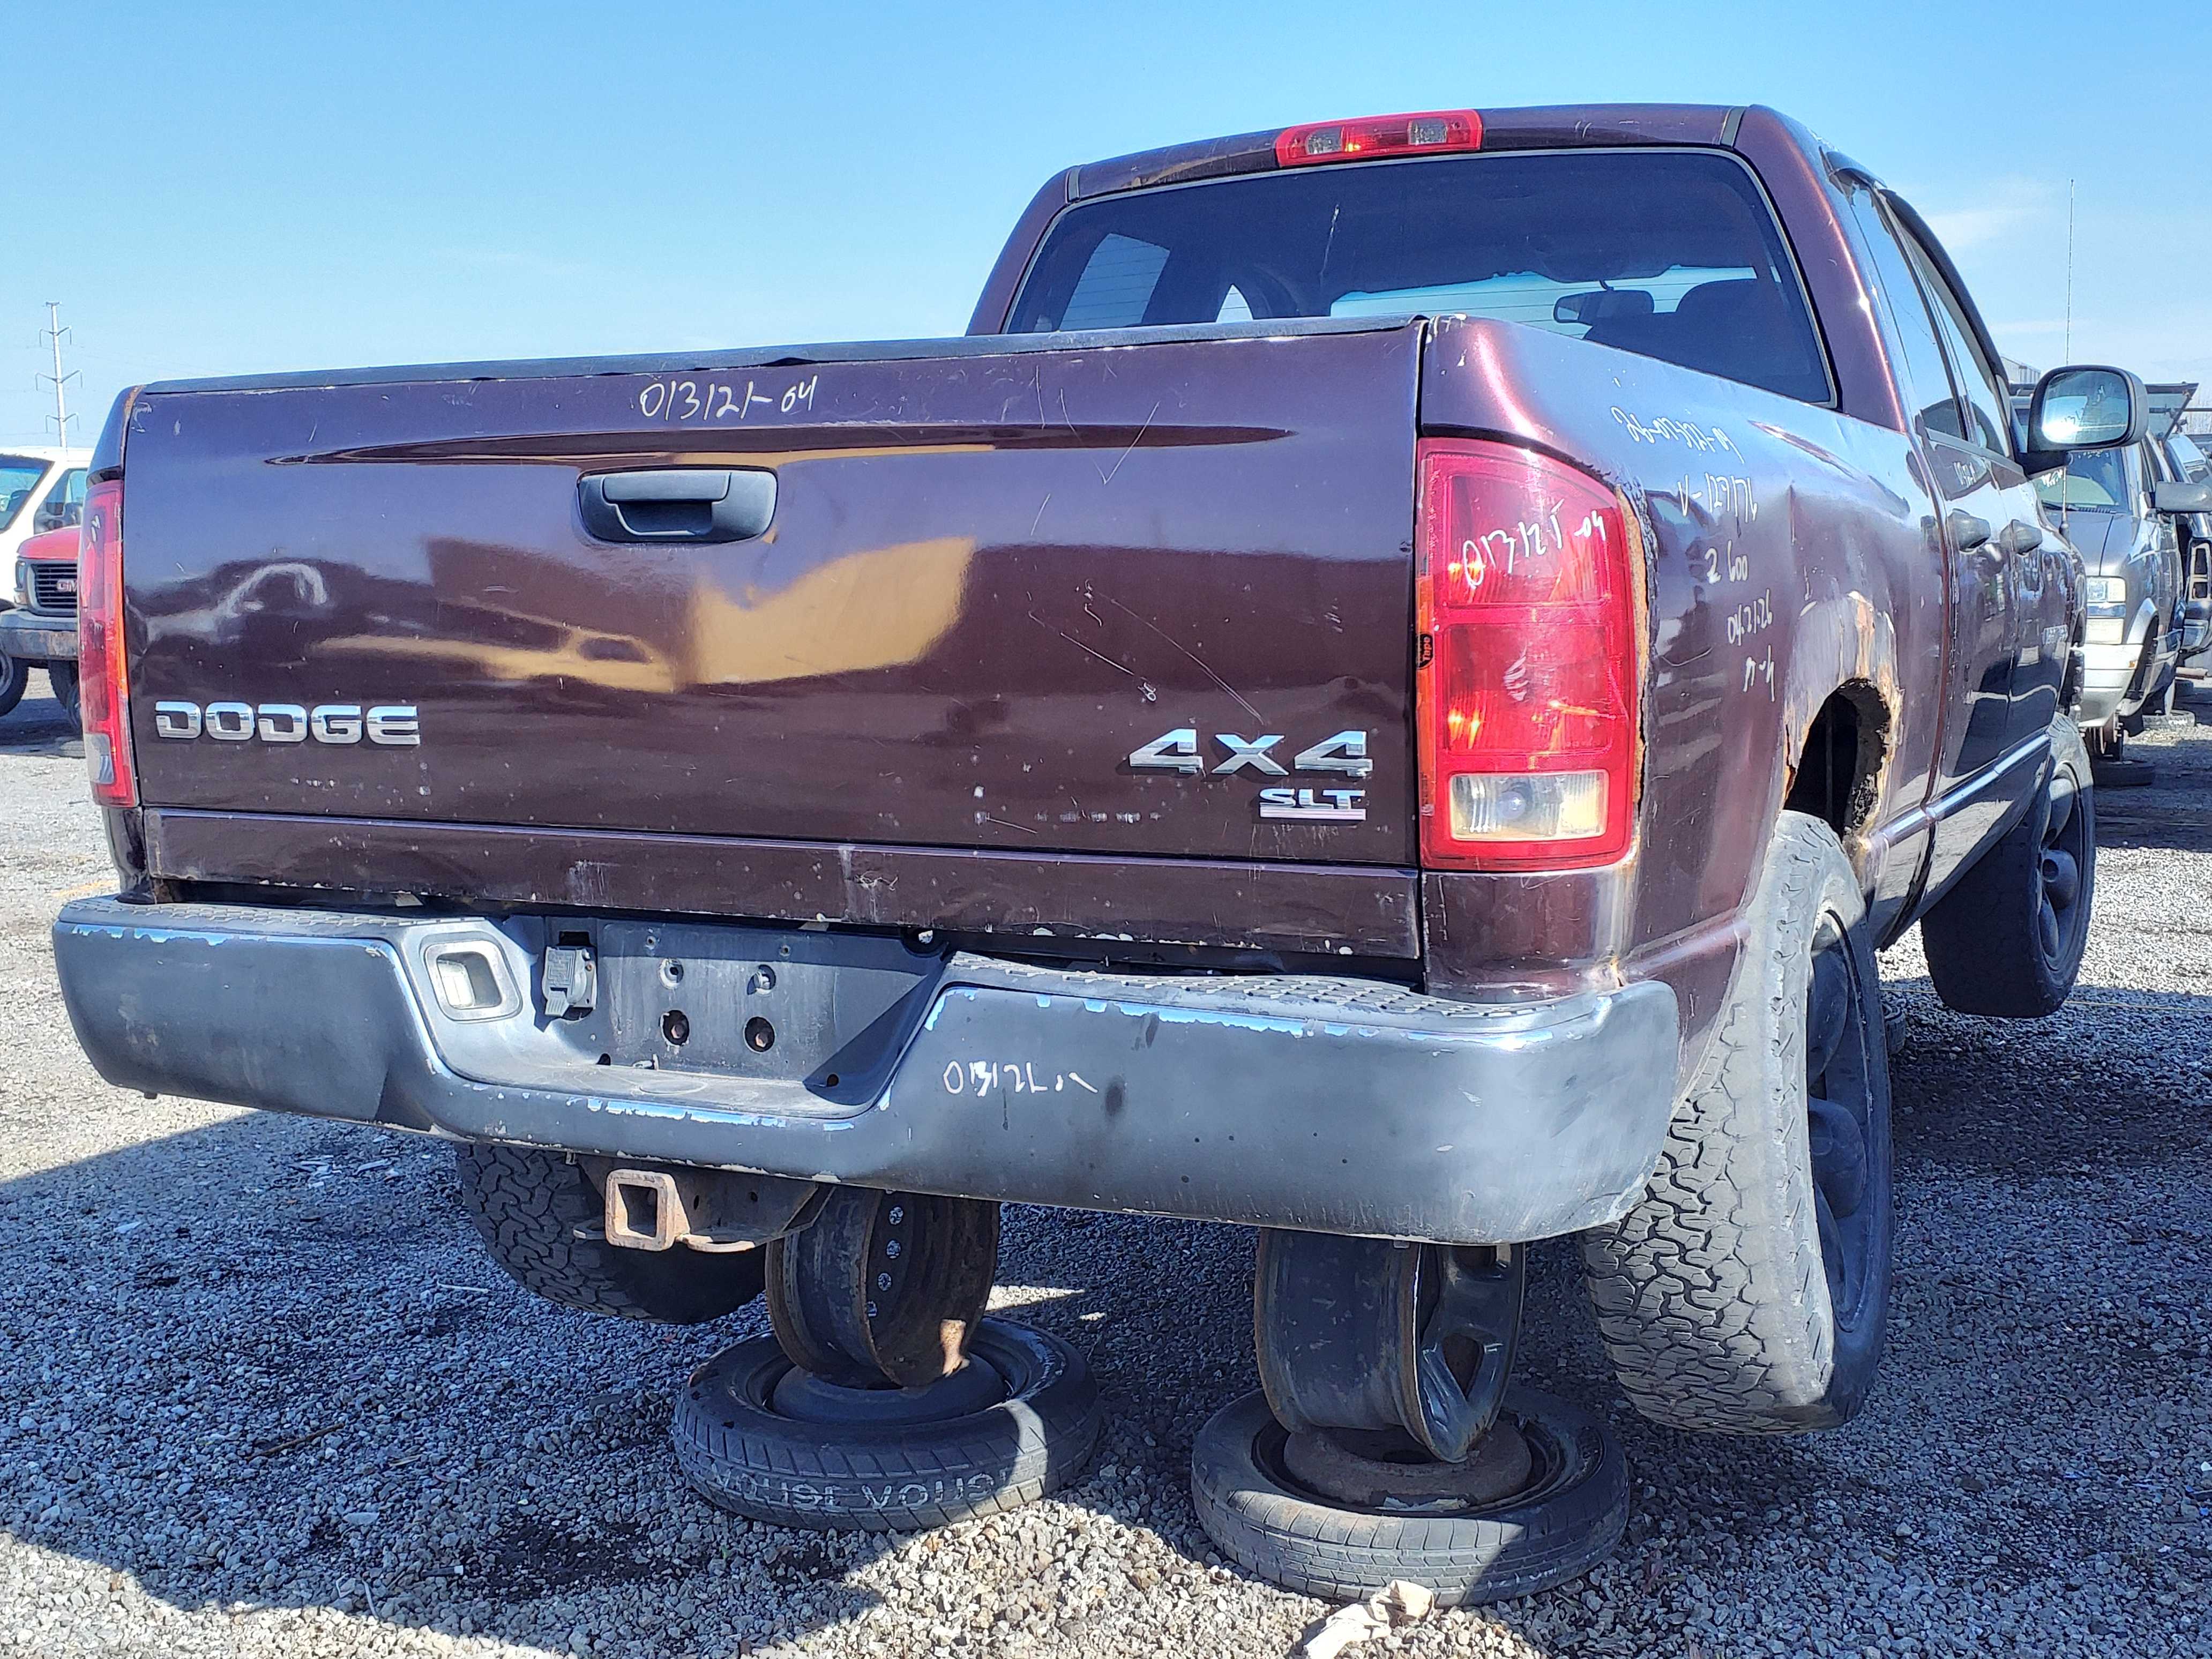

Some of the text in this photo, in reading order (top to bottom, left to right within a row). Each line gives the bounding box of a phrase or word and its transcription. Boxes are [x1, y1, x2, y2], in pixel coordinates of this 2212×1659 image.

[56, 578, 78, 592] GM
[154, 700, 421, 745] DODGE
[1259, 788, 1366, 810] SLT
